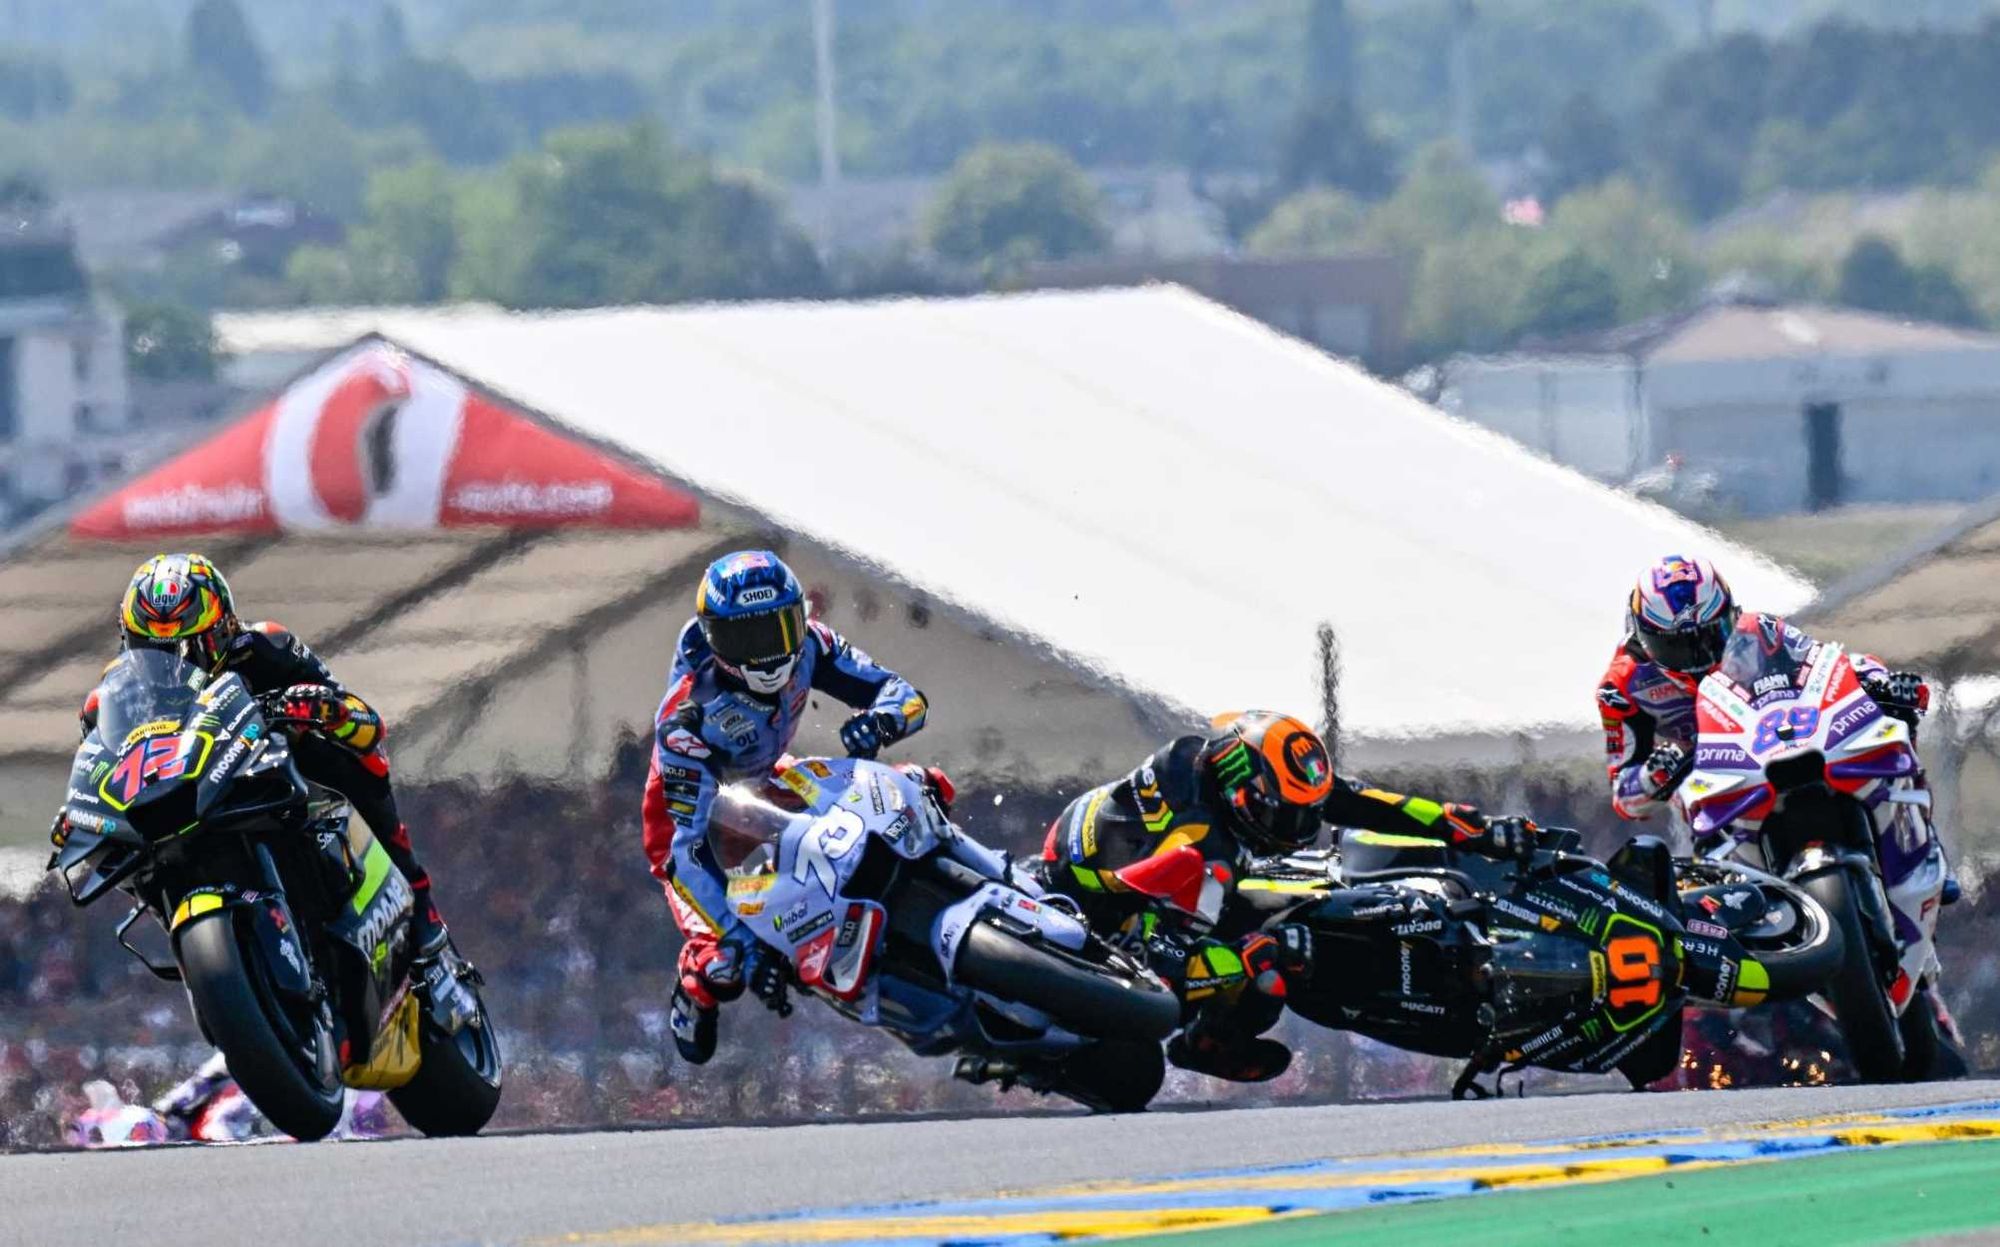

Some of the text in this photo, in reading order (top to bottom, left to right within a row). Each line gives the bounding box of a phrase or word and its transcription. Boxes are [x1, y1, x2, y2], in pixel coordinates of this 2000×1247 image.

[152, 593, 178, 605] agv
[743, 588, 774, 603] SHOEI
[1753, 674, 1790, 696] FIAMM
[1757, 688, 1796, 706] prima
[1830, 700, 1878, 736] prima
[1752, 706, 1819, 755] 89
[1696, 748, 1746, 765] prima
[111, 736, 188, 802] 72
[885, 814, 910, 840] BOLD
[793, 803, 866, 902] 73
[1396, 919, 1442, 936] DUCATI
[1399, 940, 1414, 995] mooney
[1607, 936, 1661, 1008] 10
[1400, 1001, 1446, 1016] DUCATI
